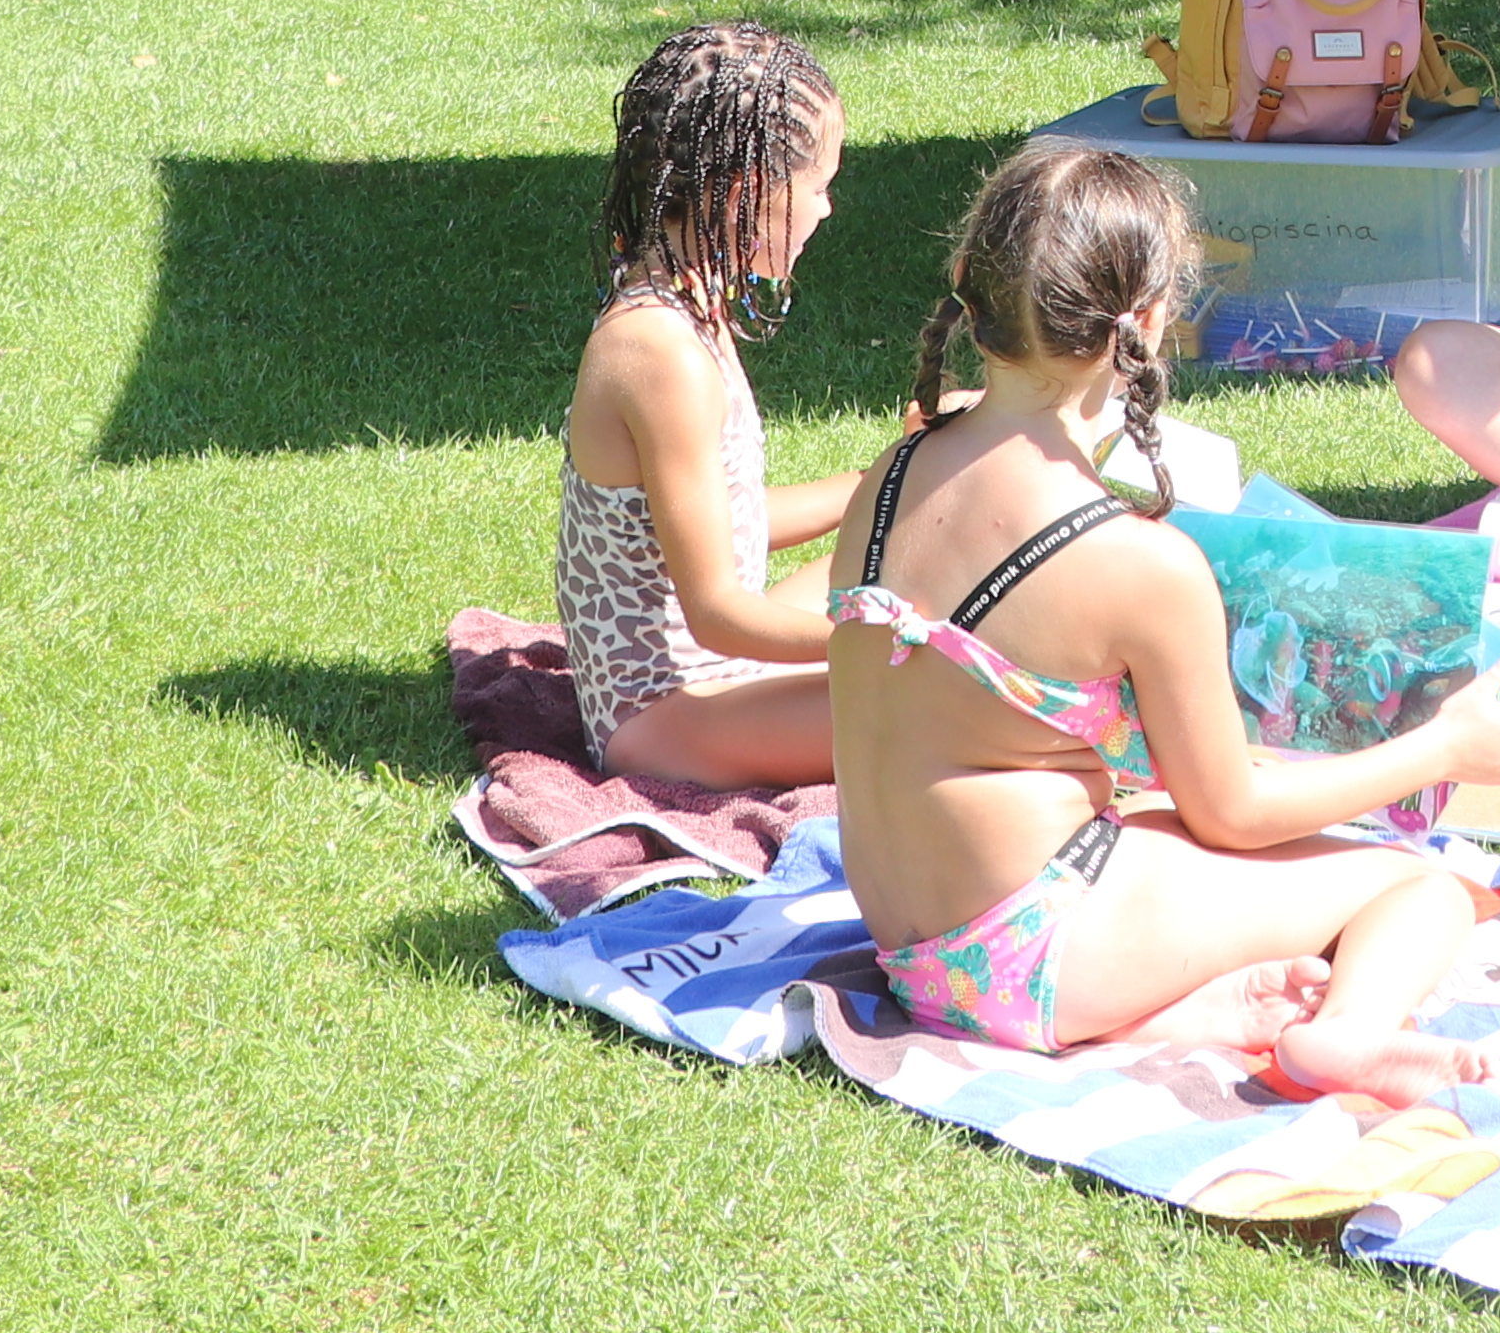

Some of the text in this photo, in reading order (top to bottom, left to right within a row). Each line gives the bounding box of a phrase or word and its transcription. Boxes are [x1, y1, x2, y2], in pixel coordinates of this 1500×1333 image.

[875, 484, 897, 539] intimo
[988, 564, 1021, 598] pink
[1019, 526, 1071, 568] intimo
[1072, 505, 1108, 532] pink
